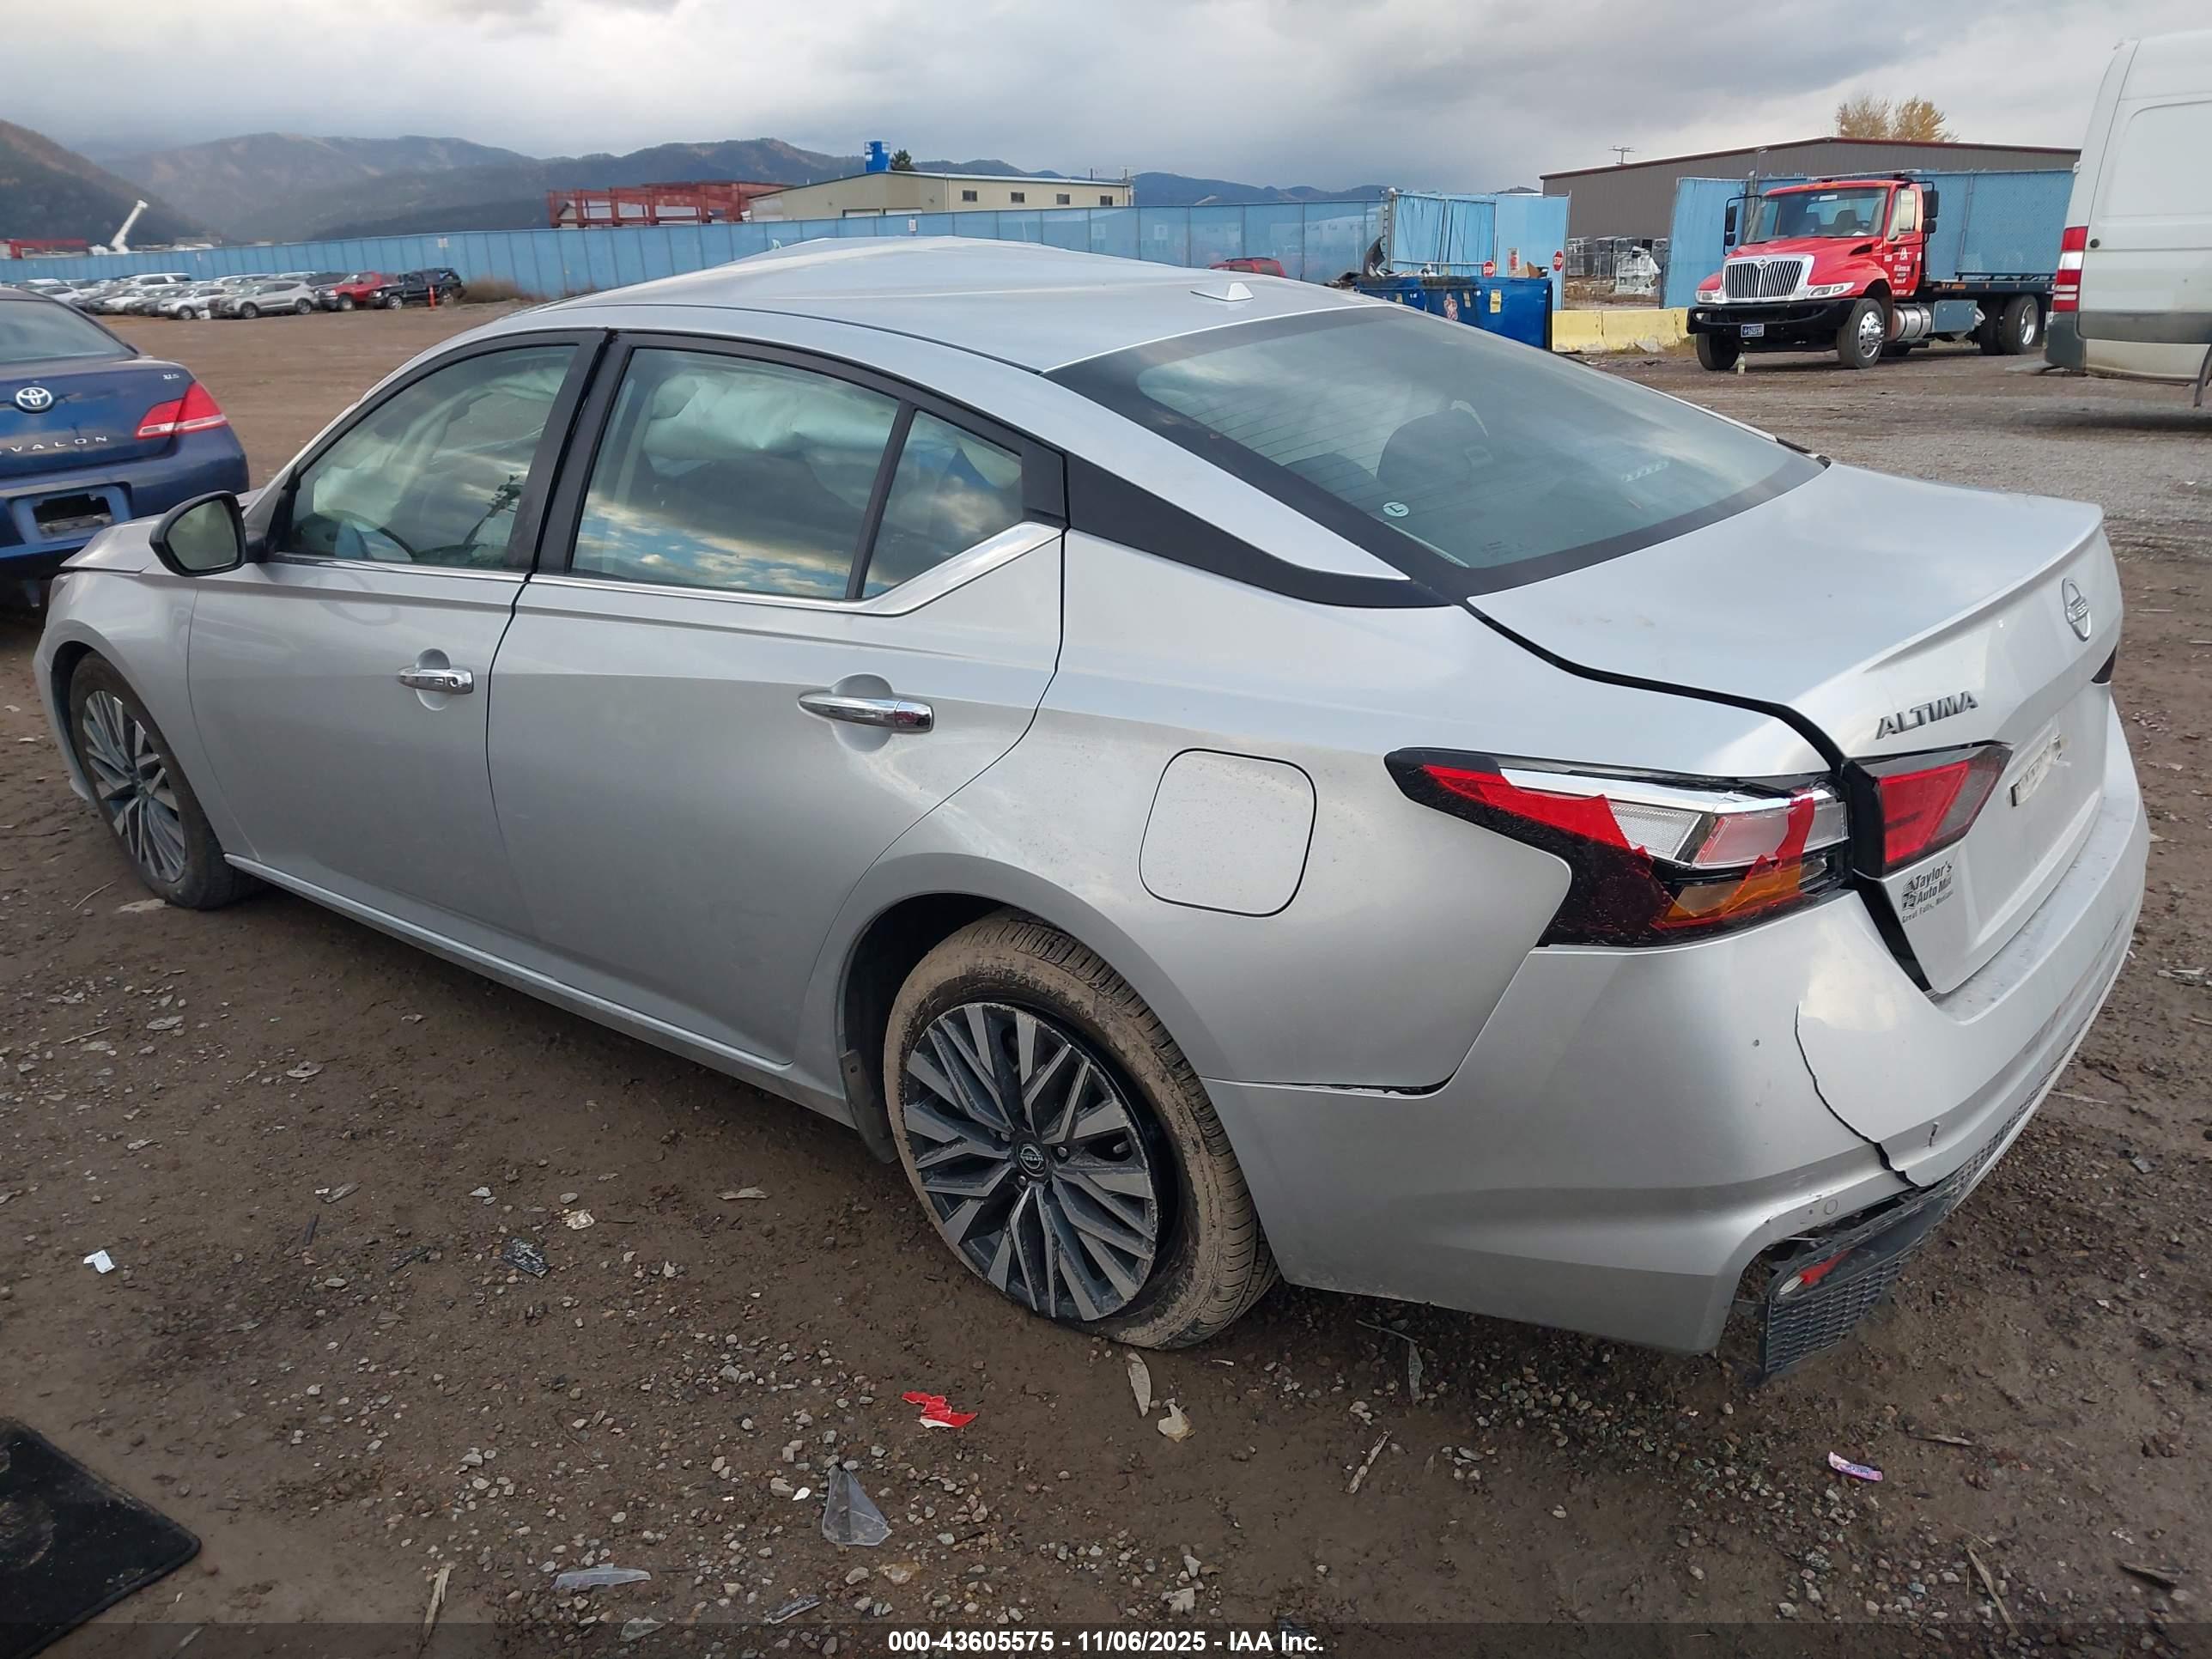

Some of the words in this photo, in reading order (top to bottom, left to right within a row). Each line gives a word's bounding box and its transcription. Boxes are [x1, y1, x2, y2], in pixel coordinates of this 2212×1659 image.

[0, 435, 107, 456] VALON
[1875, 690, 1978, 739] ALTIMA
[1915, 860, 1952, 890] Taylor's
[1917, 885, 1937, 904] Auto
